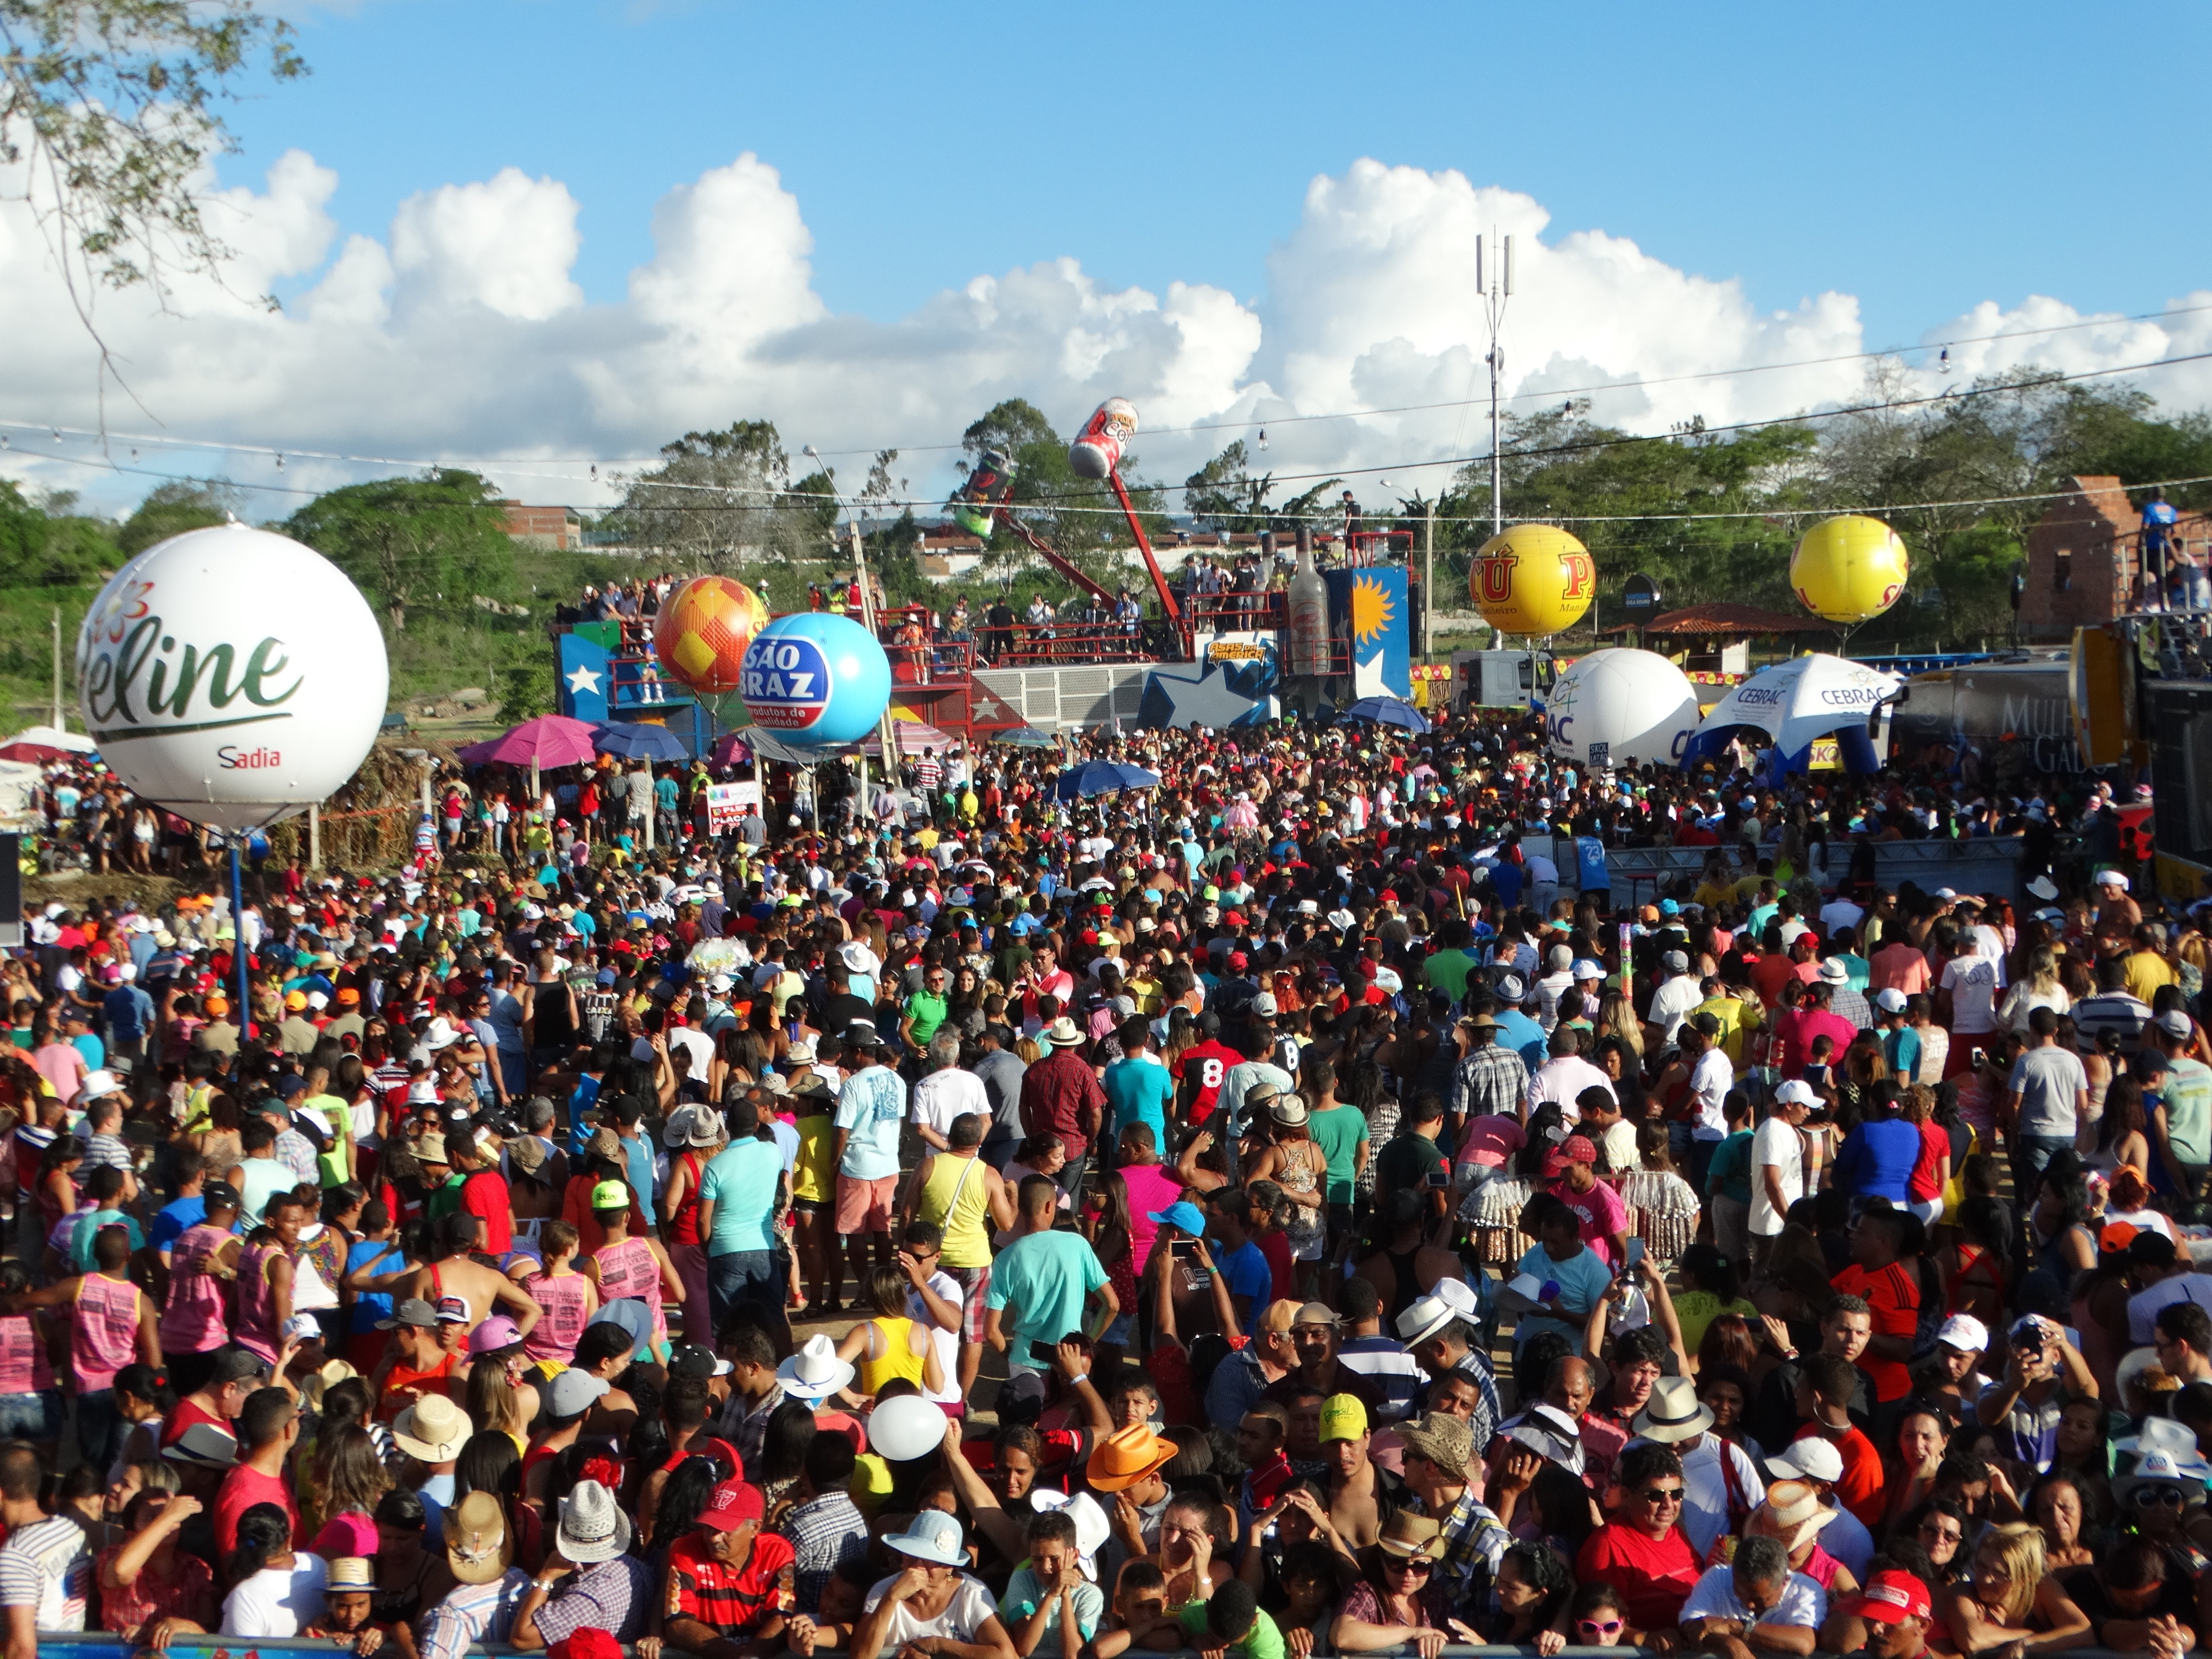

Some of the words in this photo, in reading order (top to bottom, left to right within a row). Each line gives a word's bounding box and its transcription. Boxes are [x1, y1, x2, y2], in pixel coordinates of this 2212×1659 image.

[746, 640, 800, 670] SÃO
[1210, 642, 1243, 653] ASAS
[1211, 649, 1265, 664] AMERICA
[82, 616, 304, 725] eline
[740, 671, 815, 698] BRAZ
[1738, 688, 1786, 704] CEBRAC
[1822, 687, 1884, 704] CEBRAC
[748, 707, 786, 717] produtos
[790, 707, 806, 717] de
[1590, 744, 1608, 754] SKOL
[1585, 846, 1601, 860] 23
[1285, 1041, 1298, 1071] 8
[1203, 1059, 1223, 1088] 8
